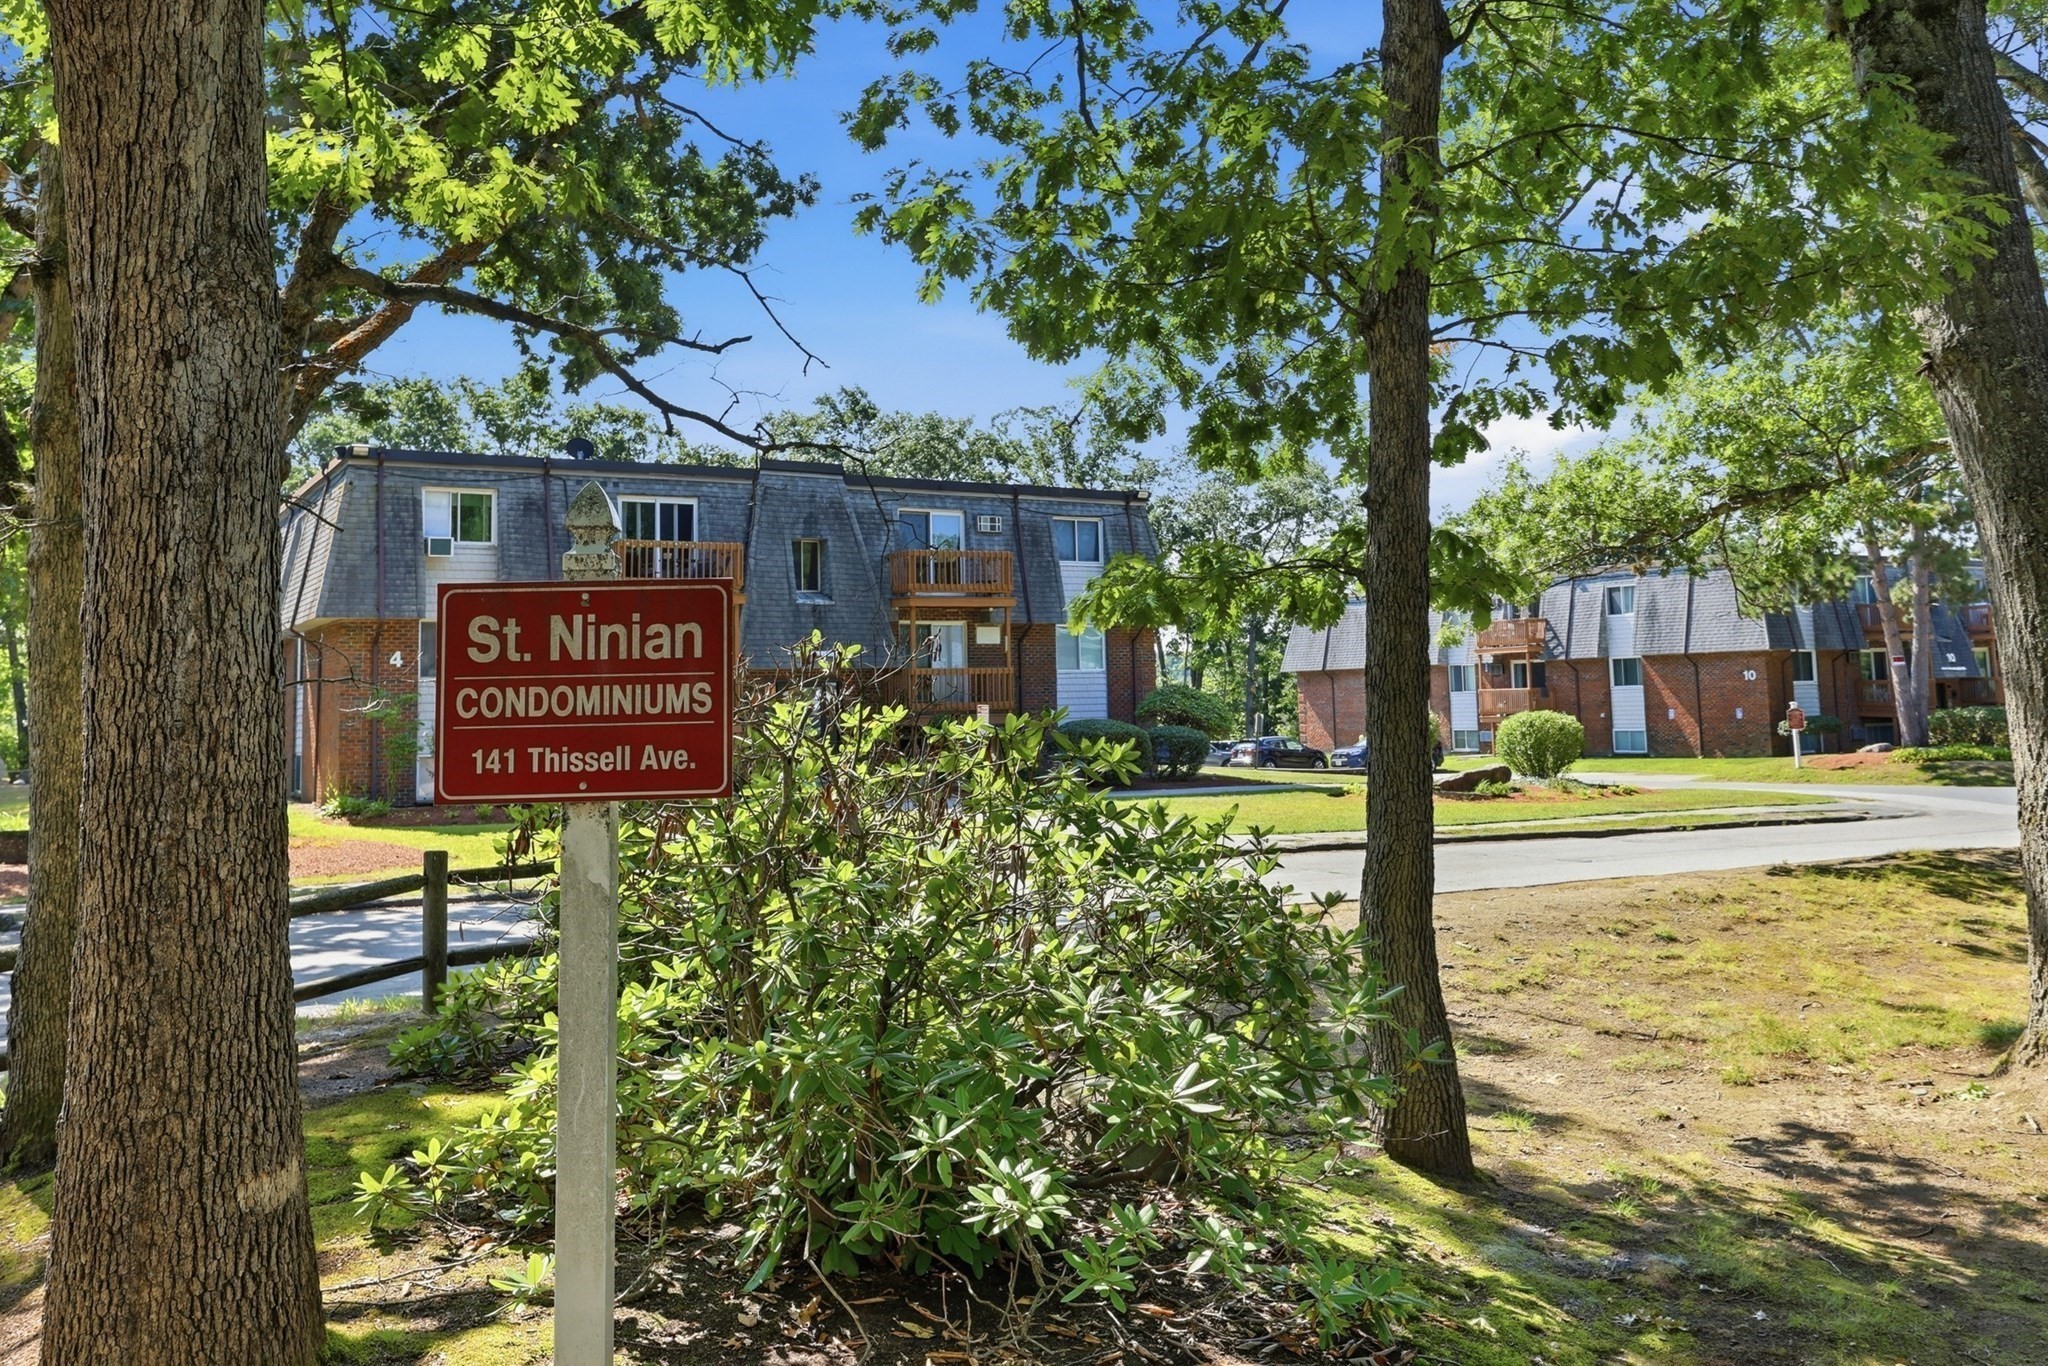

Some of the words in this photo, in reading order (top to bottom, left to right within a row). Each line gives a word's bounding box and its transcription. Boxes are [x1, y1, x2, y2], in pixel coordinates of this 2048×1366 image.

[467, 615, 531, 663] St.
[550, 613, 703, 661] Ninian
[389, 650, 404, 668] 4
[1742, 669, 1757, 681] 10
[455, 682, 713, 719] CONDOMINIUMS
[471, 748, 515, 775] 141
[527, 745, 631, 773] Thissell
[639, 744, 696, 770] Ave.
